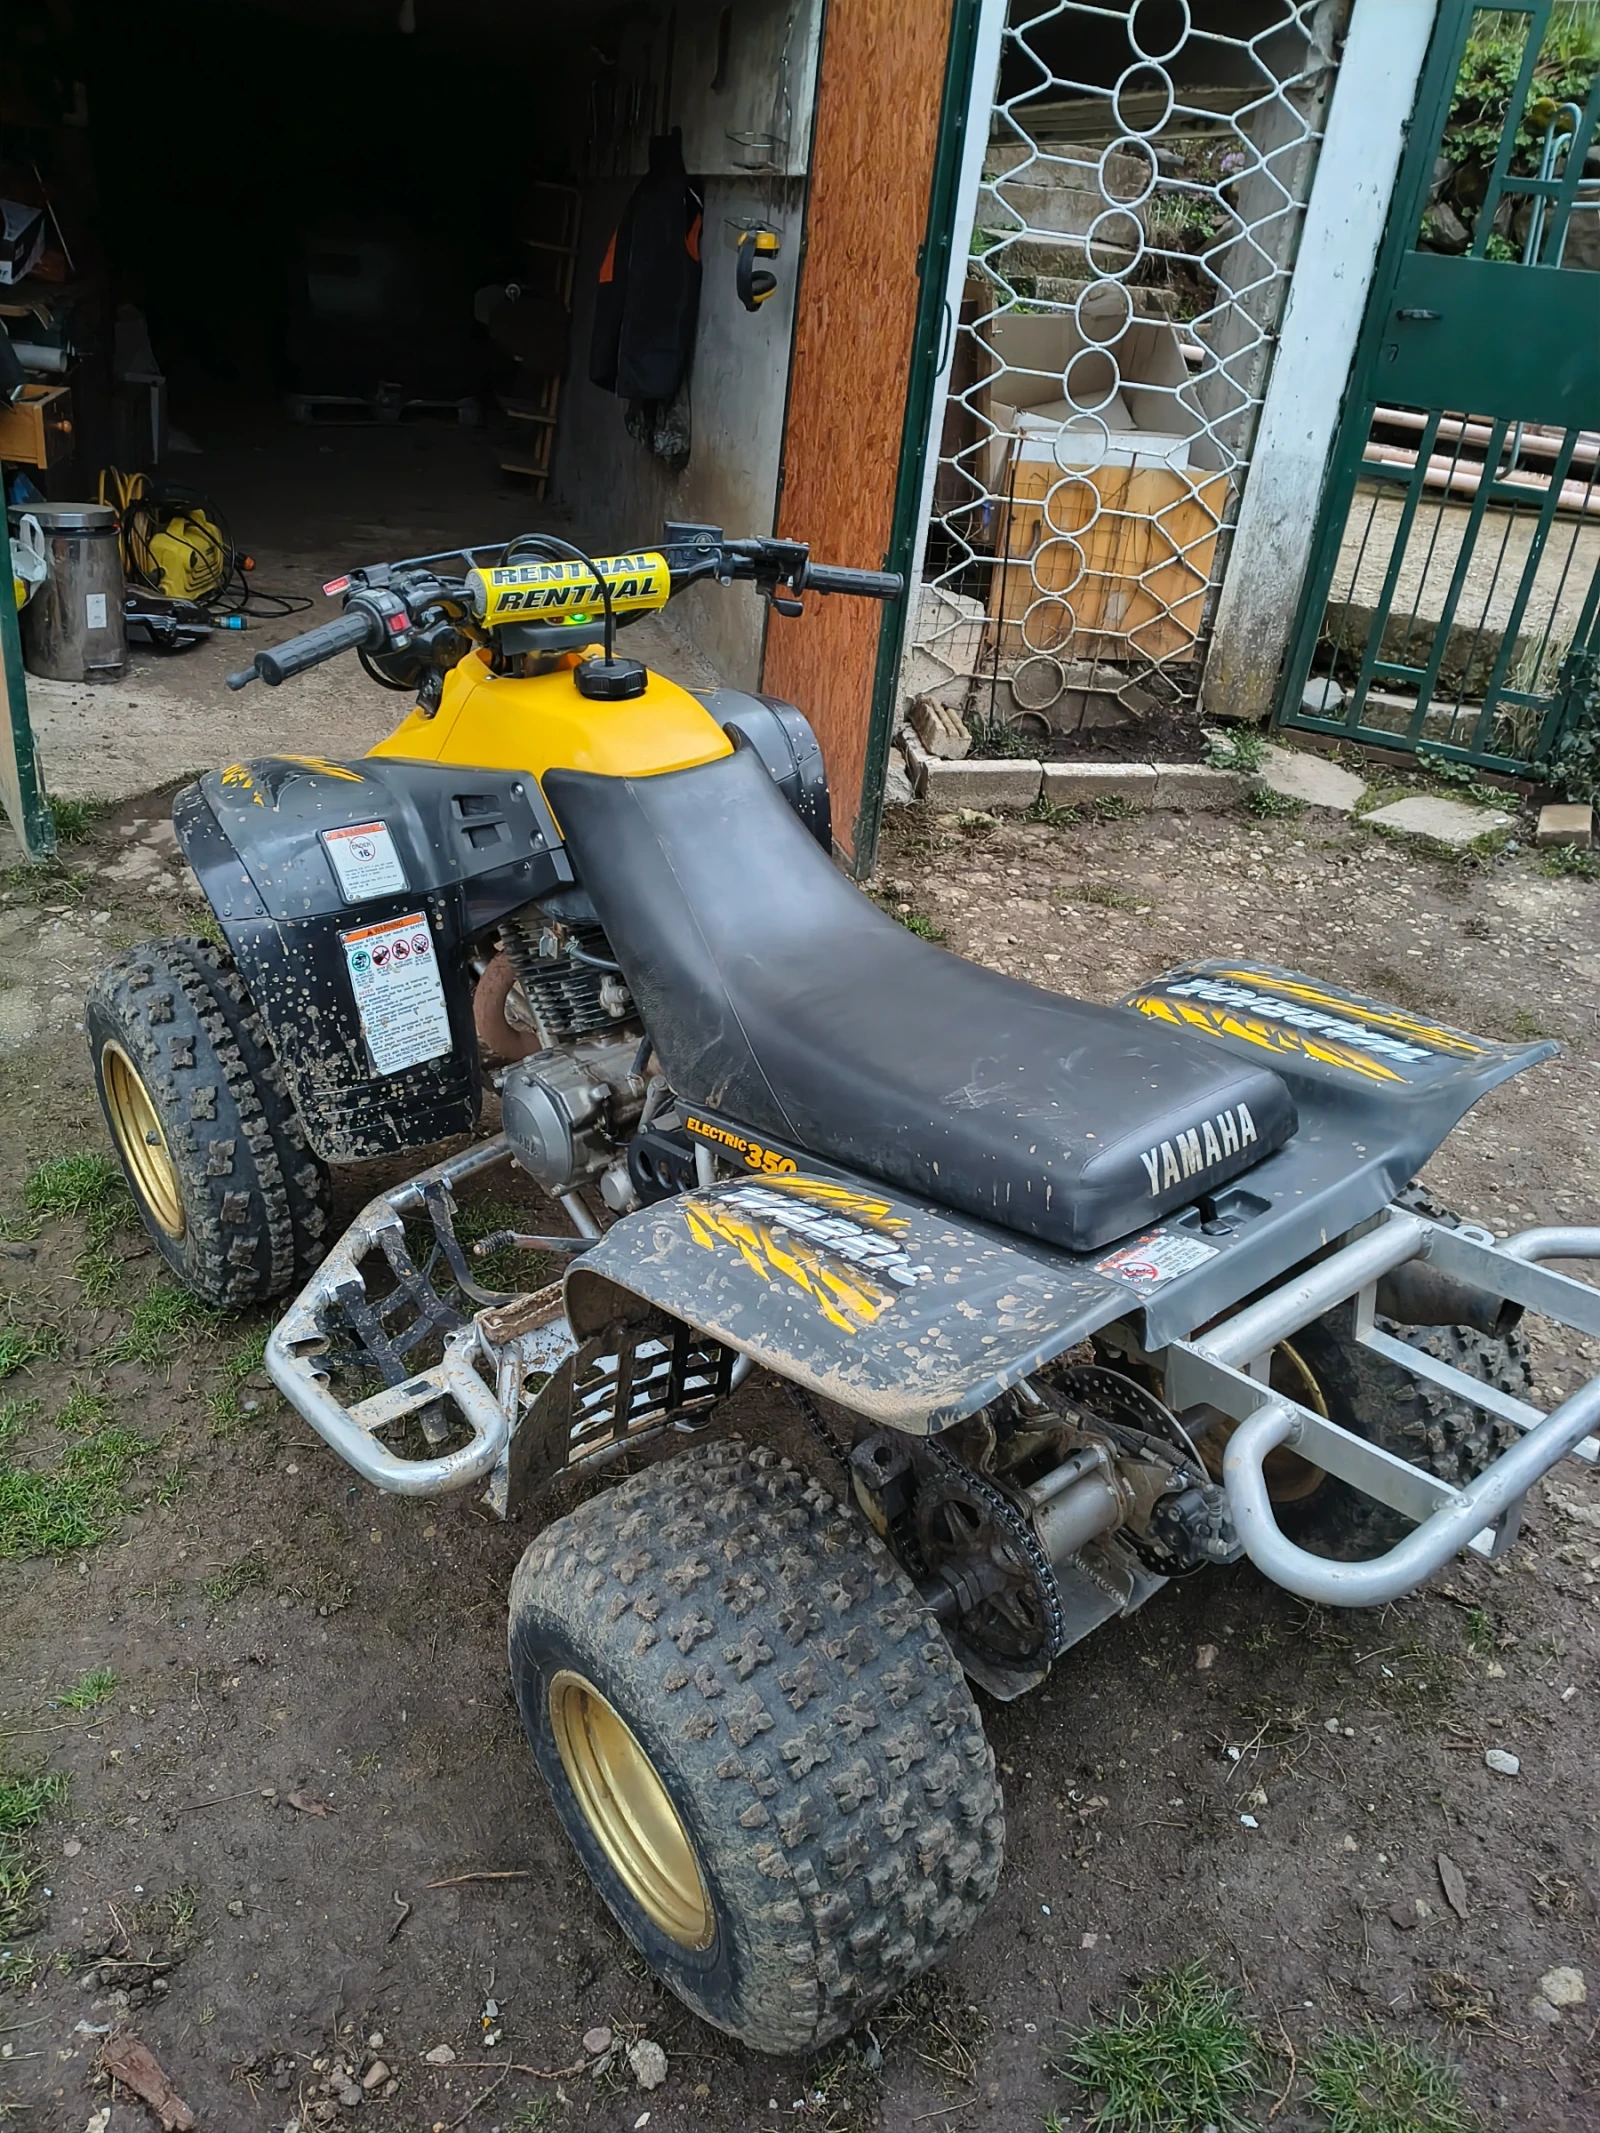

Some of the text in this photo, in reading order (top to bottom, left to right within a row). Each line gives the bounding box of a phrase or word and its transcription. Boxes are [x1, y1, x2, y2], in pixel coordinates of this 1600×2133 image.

[493, 556, 657, 586] RENTHAL
[496, 577, 659, 613] RENTHAL
[358, 849, 370, 858] 16
[374, 920, 404, 934] WARNING
[686, 1117, 798, 1174] ELECTRIC 350
[1140, 1103, 1258, 1197] YAMAHA
